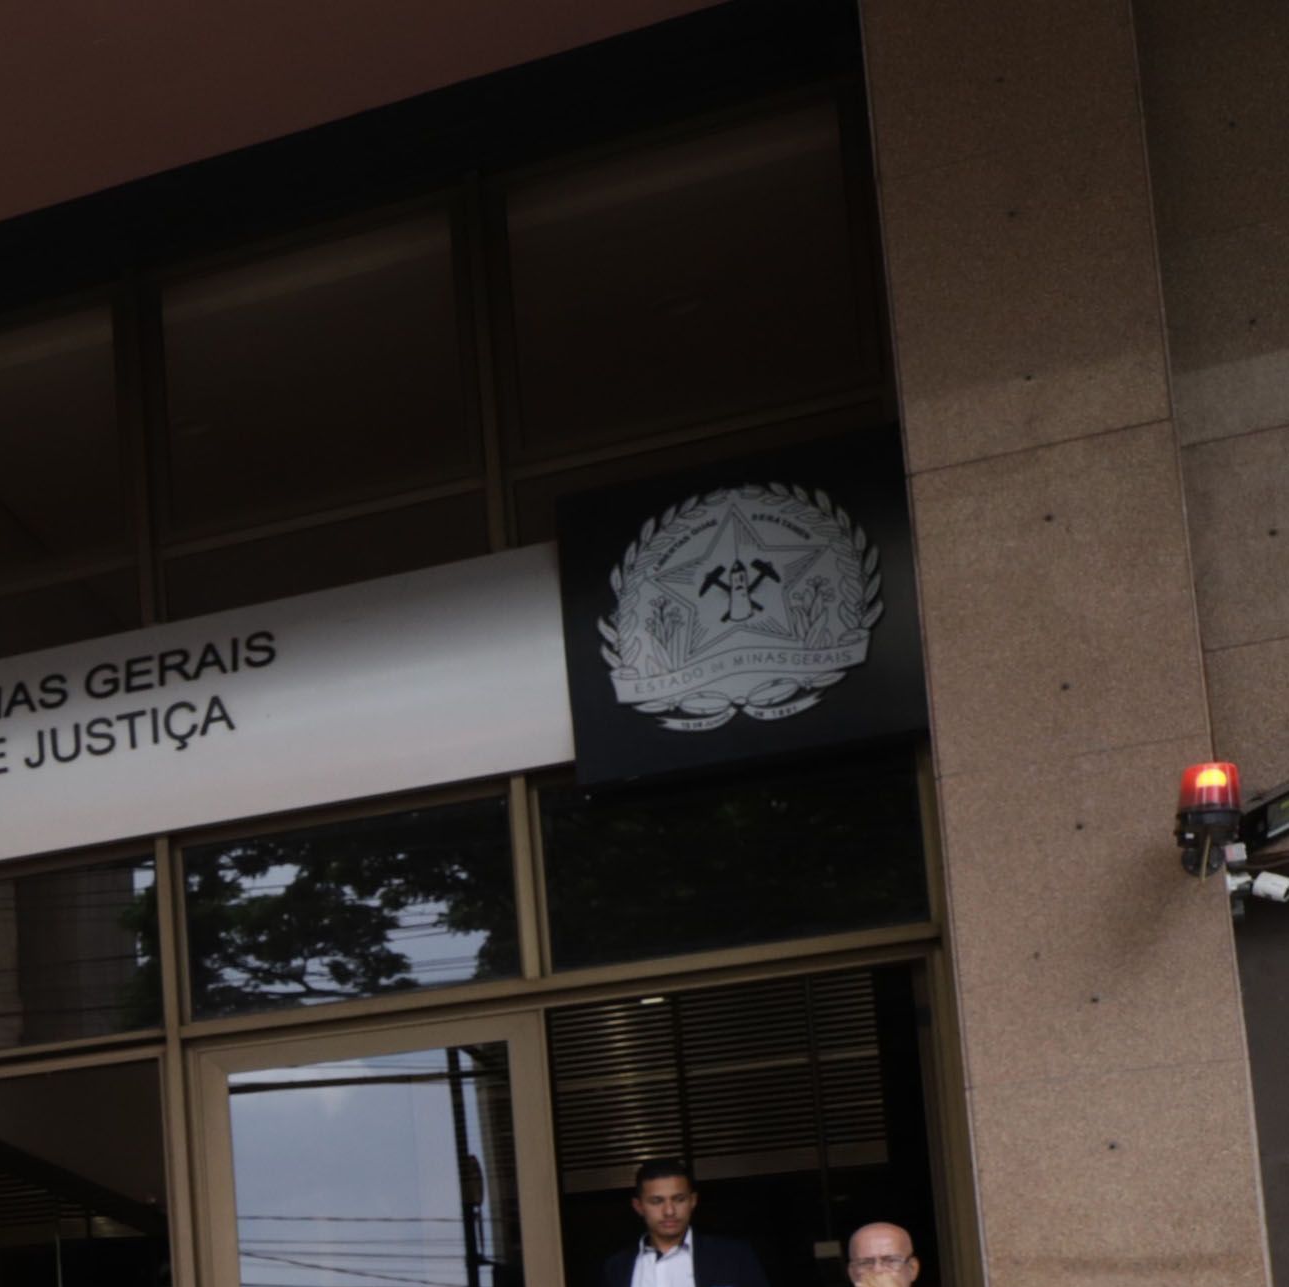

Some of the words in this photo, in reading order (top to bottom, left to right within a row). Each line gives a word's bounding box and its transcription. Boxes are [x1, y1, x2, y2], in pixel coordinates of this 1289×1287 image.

[83, 629, 277, 700] GERAIS
[634, 667, 704, 694] ESTADO
[732, 650, 788, 667] MINAS
[791, 649, 853, 666] GERAIS
[23, 694, 237, 770] JUSTIÇA
